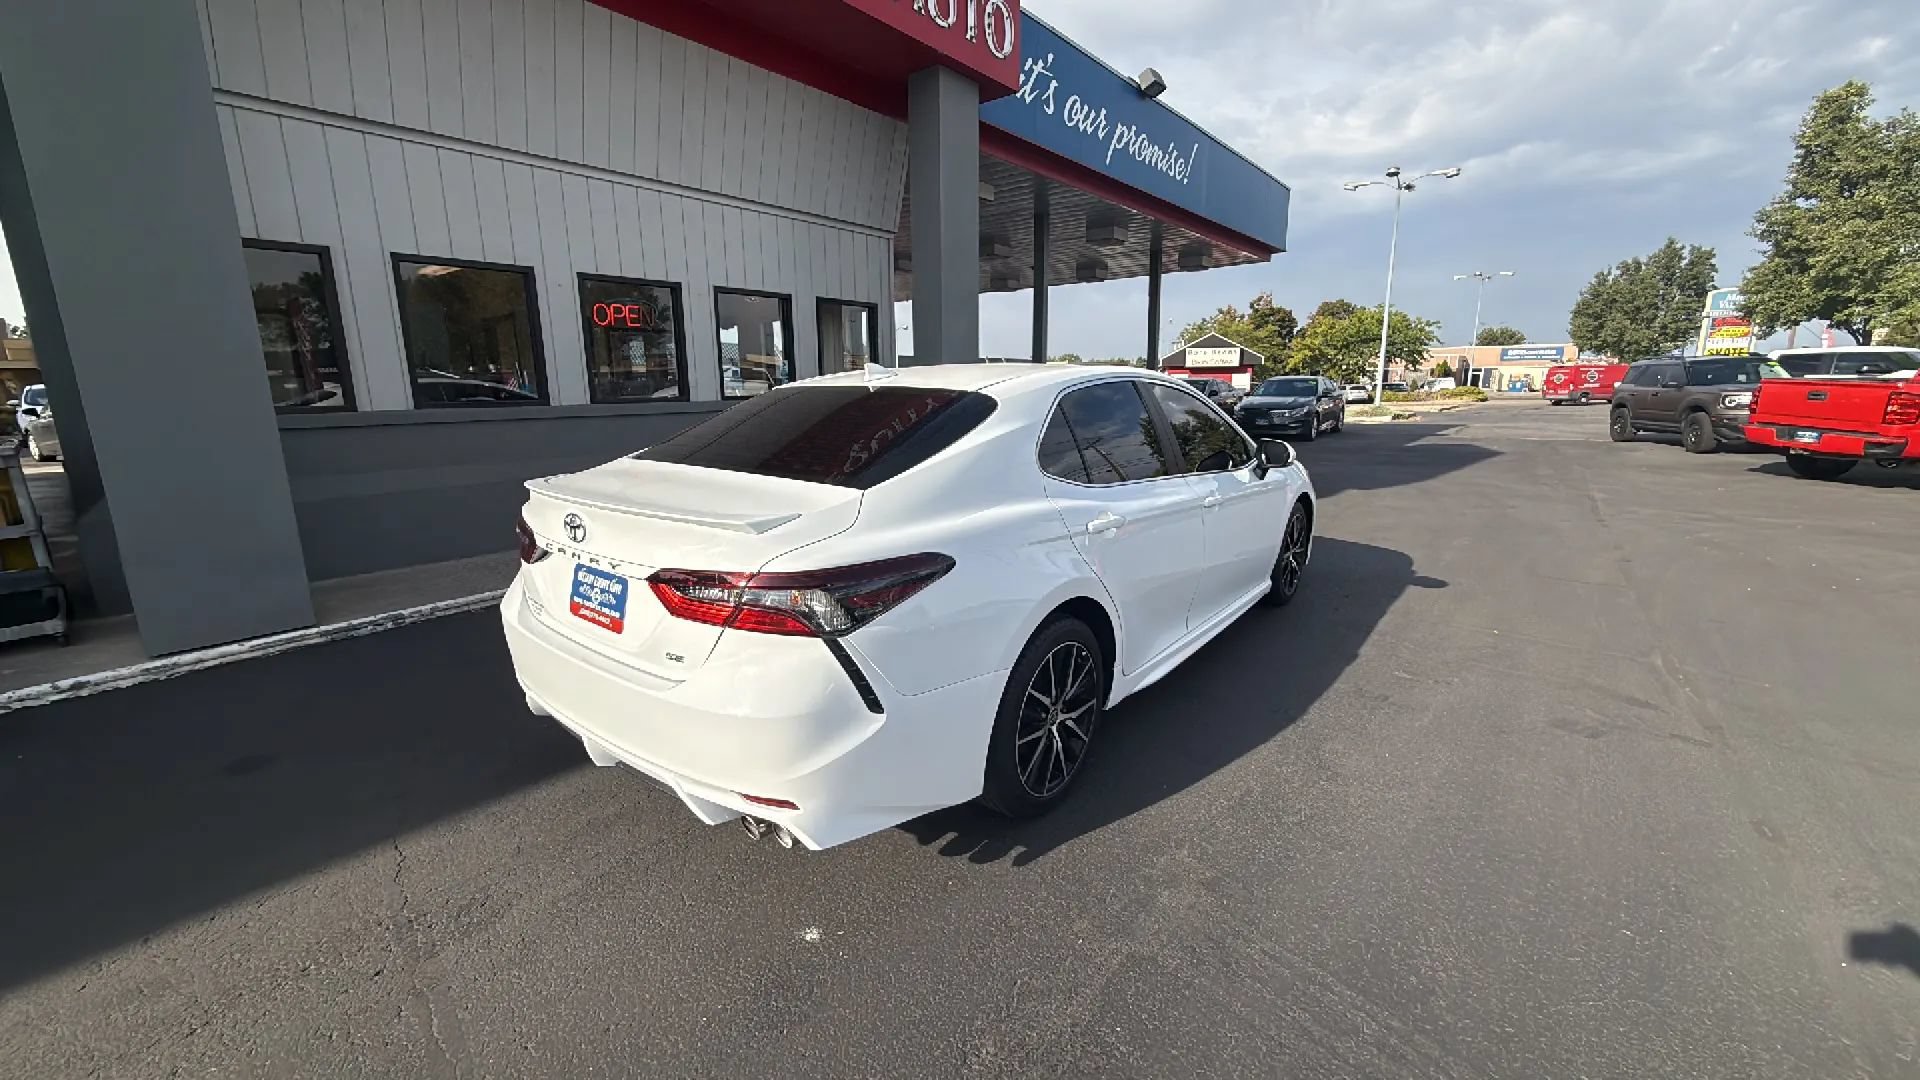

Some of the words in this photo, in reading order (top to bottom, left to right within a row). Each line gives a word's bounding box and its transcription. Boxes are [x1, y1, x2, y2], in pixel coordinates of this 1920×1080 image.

[913, 0, 1014, 59] UTO
[1016, 52, 1058, 115] it's
[1063, 94, 1109, 140] our
[1106, 121, 1198, 185] promise!
[593, 303, 655, 327] OPEN
